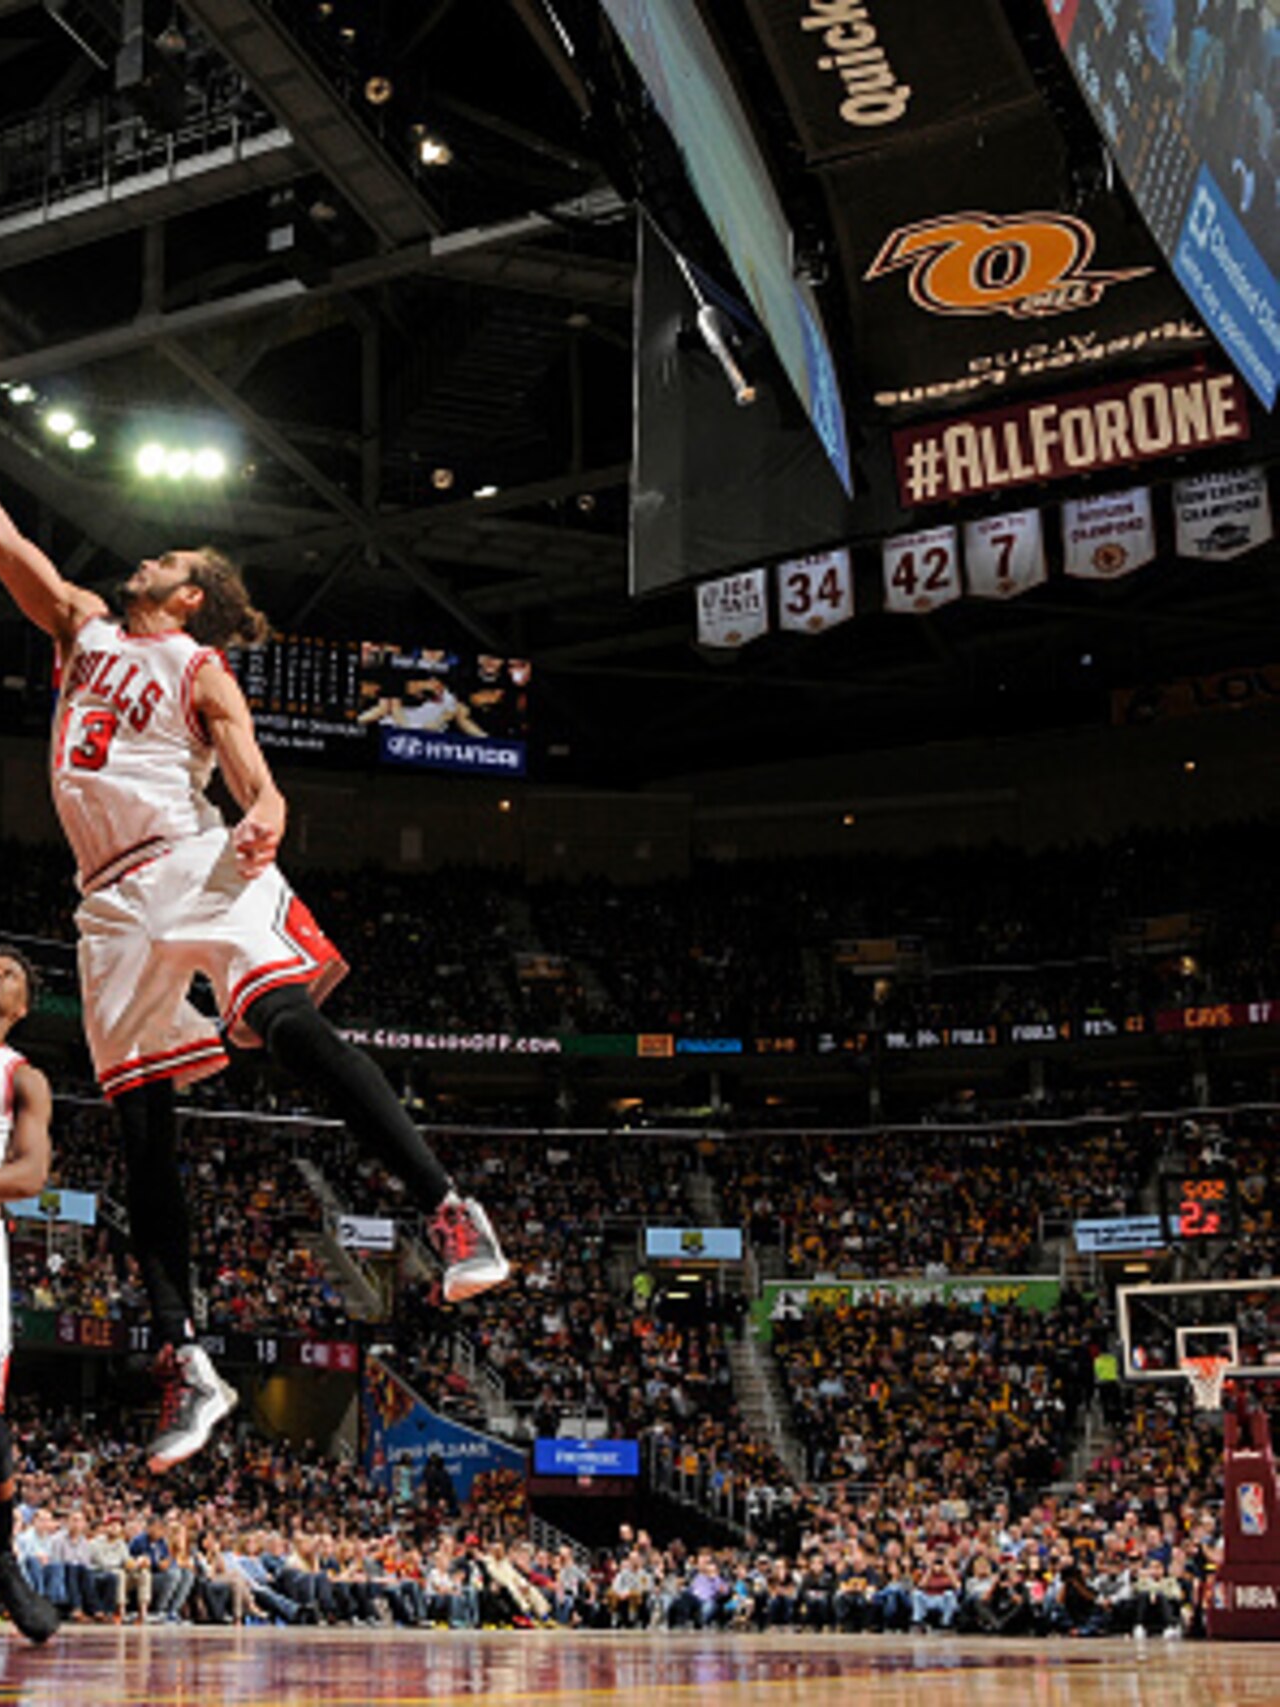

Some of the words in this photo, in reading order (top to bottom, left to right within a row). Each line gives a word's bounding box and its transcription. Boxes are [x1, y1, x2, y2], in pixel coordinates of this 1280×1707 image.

[905, 374, 1241, 501] #ALLFORONE
[891, 547, 951, 595] 42
[991, 533, 1018, 579] 7
[786, 566, 845, 615] 34
[1235, 1584, 1277, 1609] NBA
